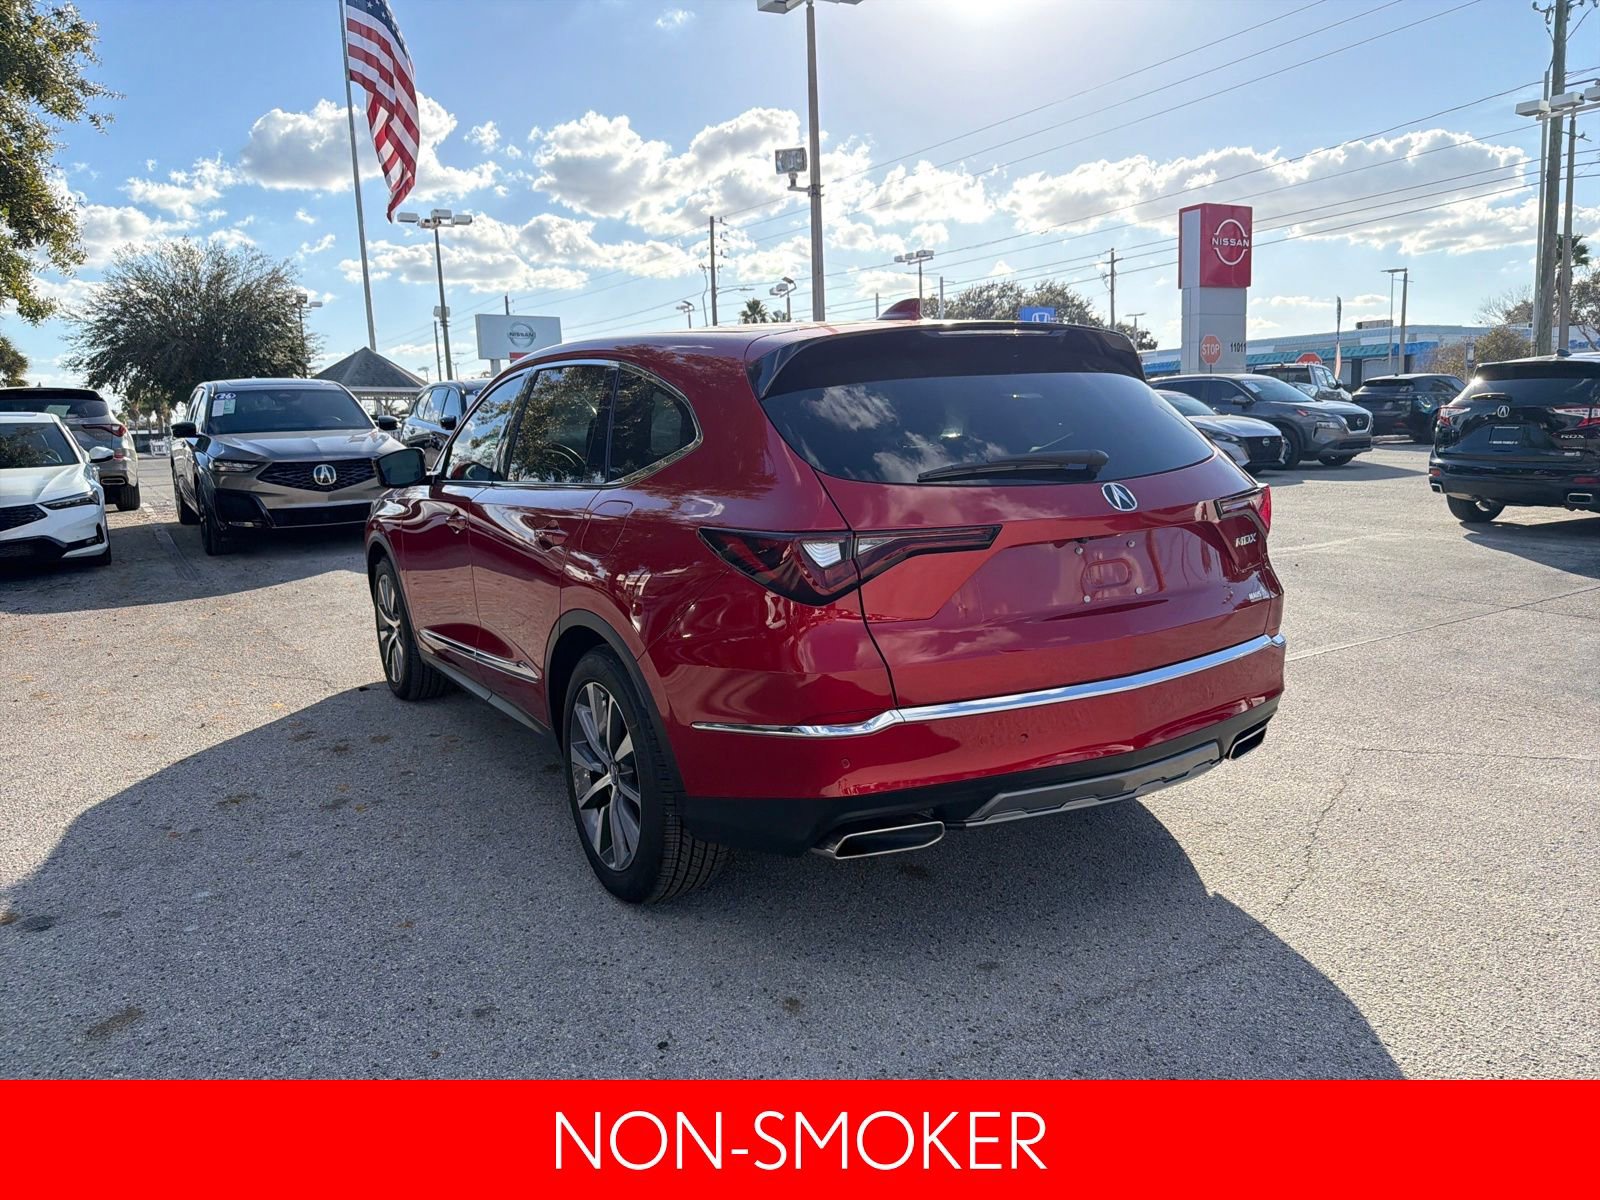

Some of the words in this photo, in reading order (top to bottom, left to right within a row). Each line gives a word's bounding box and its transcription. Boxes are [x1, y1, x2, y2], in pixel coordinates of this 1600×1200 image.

[1211, 237, 1249, 247] NISSAN
[1201, 343, 1220, 356] STOP
[1235, 532, 1257, 548] MDX
